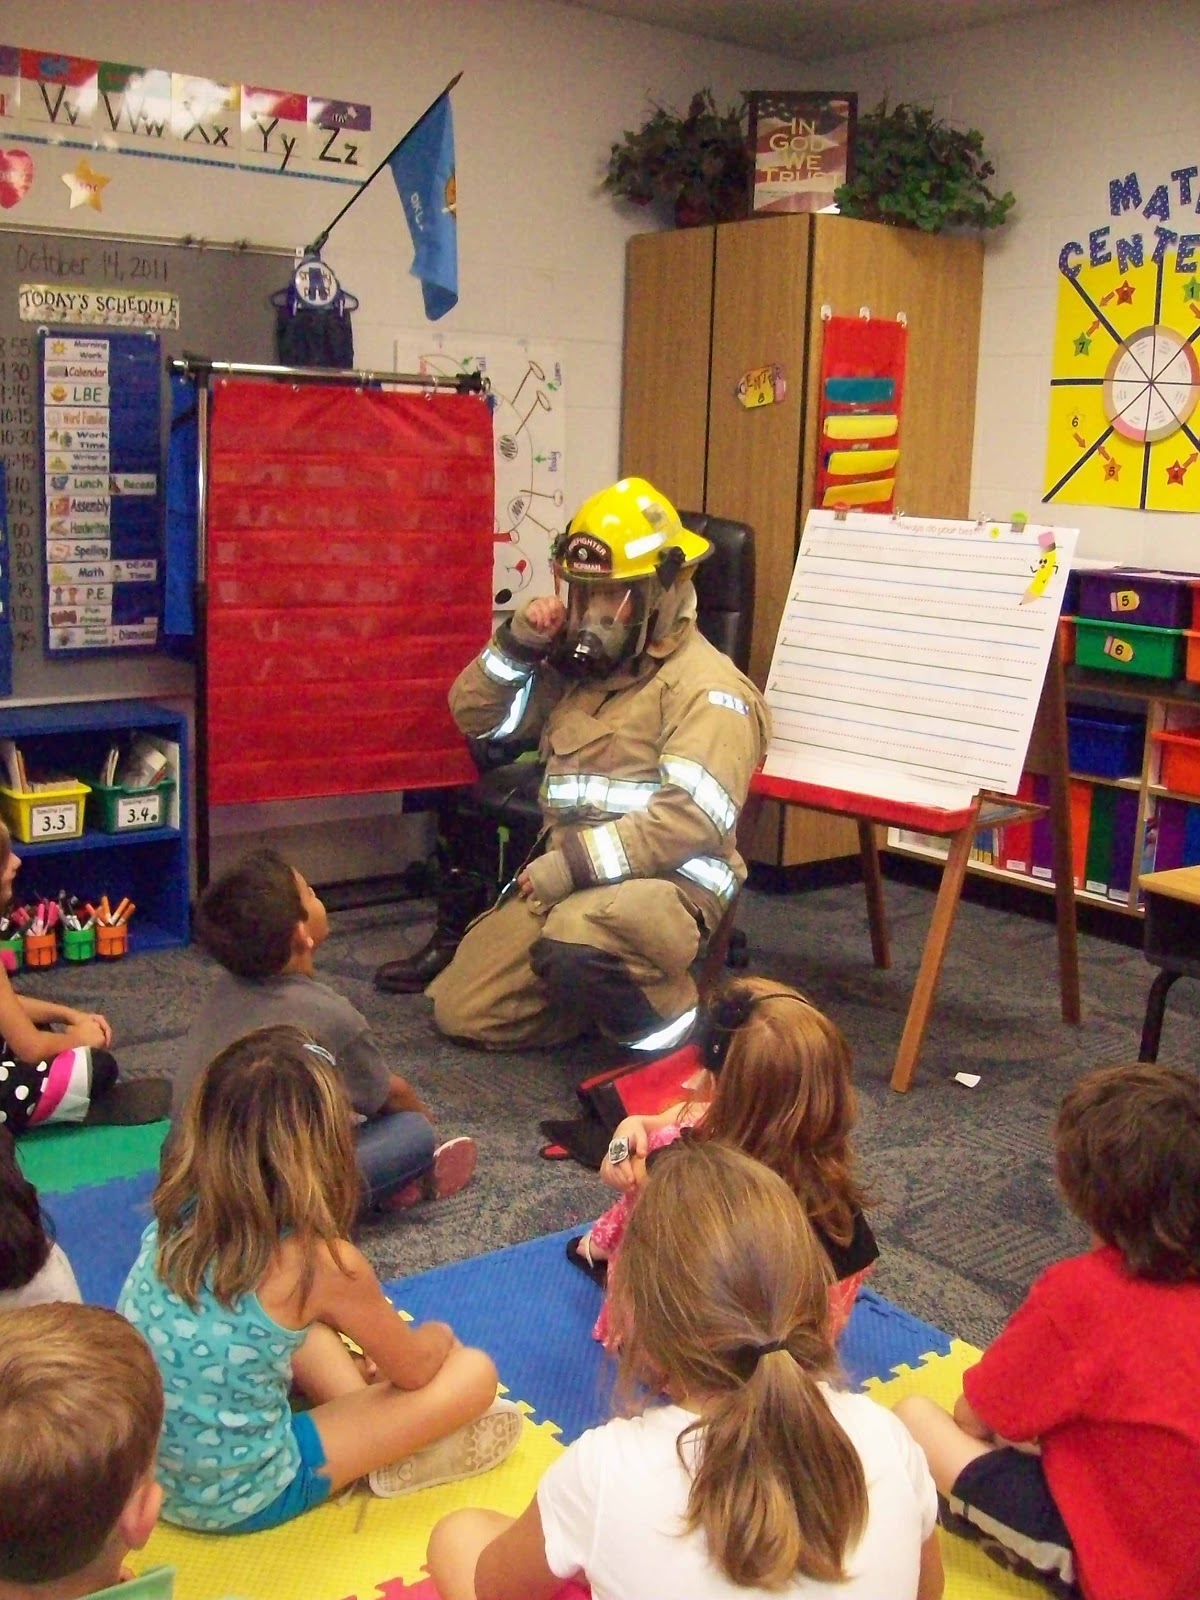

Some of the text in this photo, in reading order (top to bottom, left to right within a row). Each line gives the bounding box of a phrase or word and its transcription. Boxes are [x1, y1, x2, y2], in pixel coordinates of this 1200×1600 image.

[40, 81, 80, 125] Vv
[250, 112, 296, 170] Yy
[318, 123, 358, 165] Zz
[789, 117, 816, 135] IN
[769, 133, 825, 152] GOD
[784, 151, 822, 171] WE
[1108, 166, 1200, 222] MAT
[15, 243, 169, 282] October 14, 2011
[20, 289, 178, 317] TODAY'S SCHEDULE
[74, 340, 107, 350] Morning
[1078, 341, 1086, 354] 7
[80, 351, 102, 359] Work
[69, 366, 107, 378] Calendar
[73, 386, 103, 402] LBE
[1071, 416, 1079, 428] 6
[77, 431, 108, 439] Work
[80, 441, 106, 449] Time
[1107, 466, 1116, 478] 5
[74, 478, 103, 489] Lunch
[71, 498, 109, 516] Assembly
[74, 545, 108, 559] Spelling
[79, 567, 105, 578] Math
[1121, 595, 1130, 607] 5
[1115, 644, 1124, 656] 6
[127, 807, 149, 823] 3.4
[42, 814, 66, 832] 3.3
